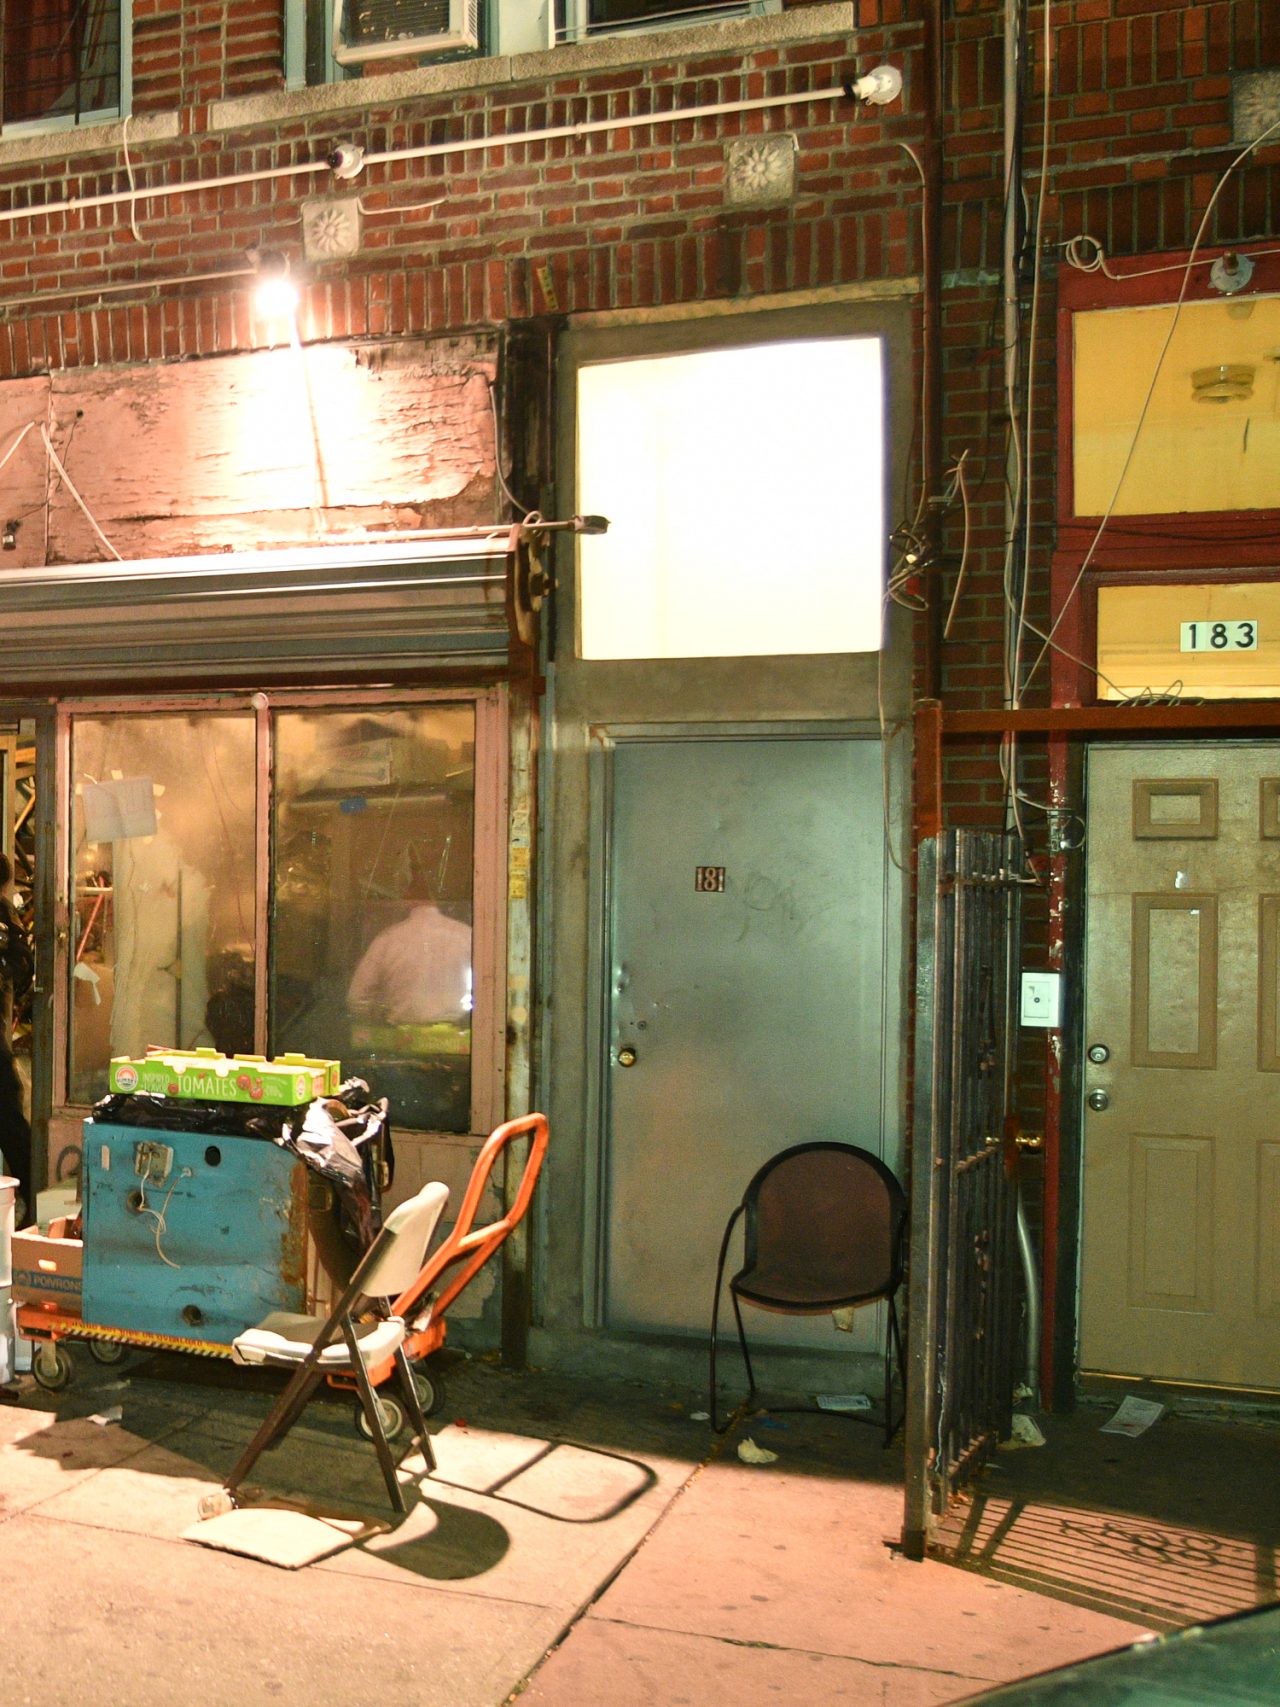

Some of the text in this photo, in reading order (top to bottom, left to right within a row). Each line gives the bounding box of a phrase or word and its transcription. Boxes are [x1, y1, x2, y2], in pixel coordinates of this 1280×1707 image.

[1188, 622, 1254, 650] 183
[697, 867, 724, 892] 181
[177, 1074, 237, 1098] TOMATES
